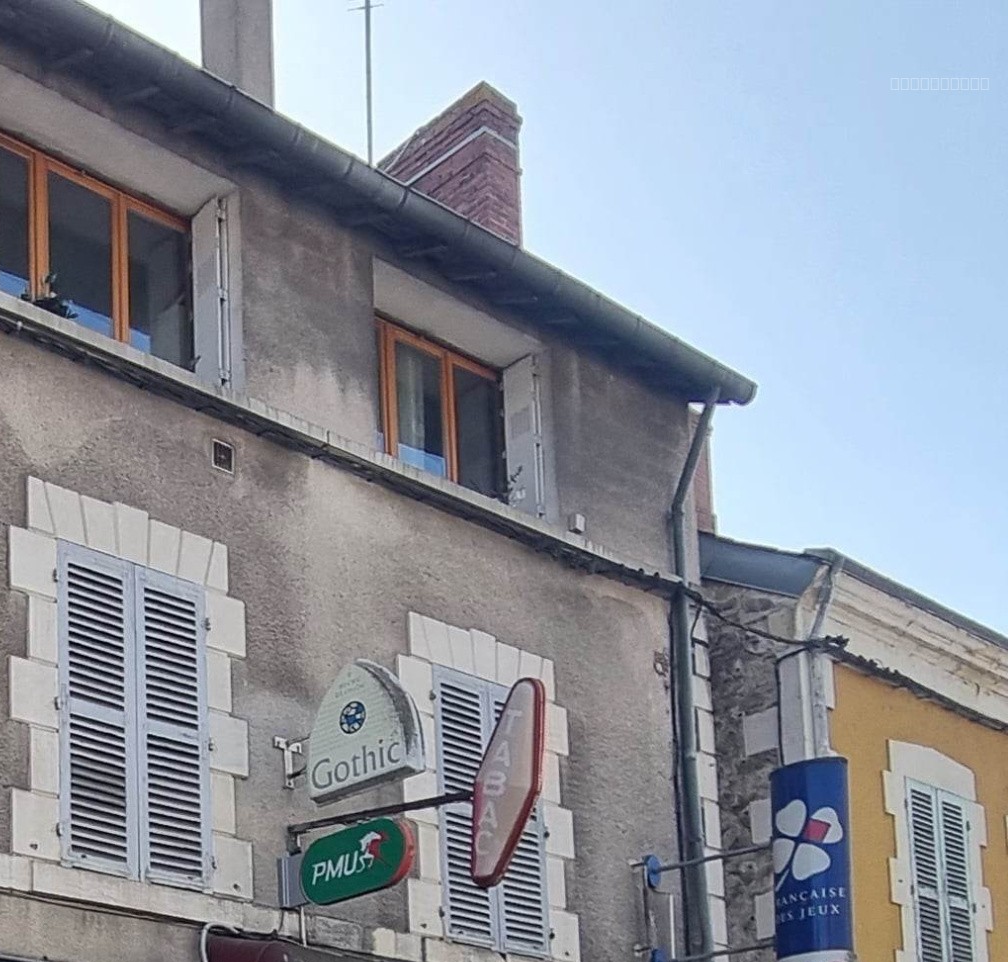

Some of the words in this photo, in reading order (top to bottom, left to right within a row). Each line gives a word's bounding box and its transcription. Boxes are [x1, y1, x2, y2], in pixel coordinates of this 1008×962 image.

[311, 739, 401, 790] Gothic
[476, 708, 522, 854] TABAC
[311, 850, 360, 886] PMU
[799, 904, 840, 920] JEUX
